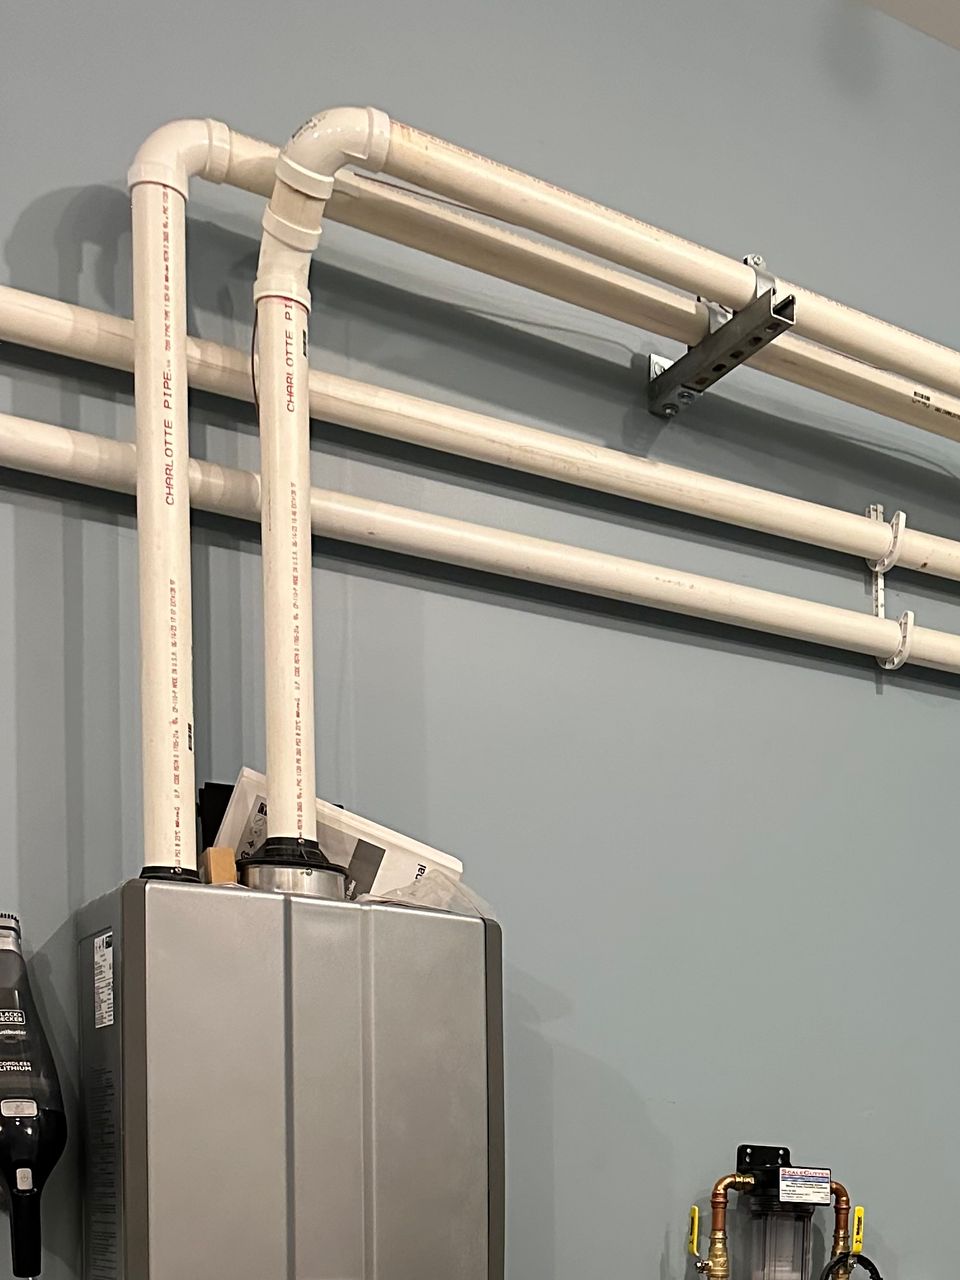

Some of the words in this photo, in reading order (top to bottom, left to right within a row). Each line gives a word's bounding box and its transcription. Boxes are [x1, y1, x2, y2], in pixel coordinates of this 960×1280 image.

[285, 303, 293, 321] PI
[163, 371, 172, 410] PIPE
[285, 330, 294, 413] CHARLOTTE
[164, 419, 174, 506] CHARLOTTE
[415, 863, 427, 880] nai
